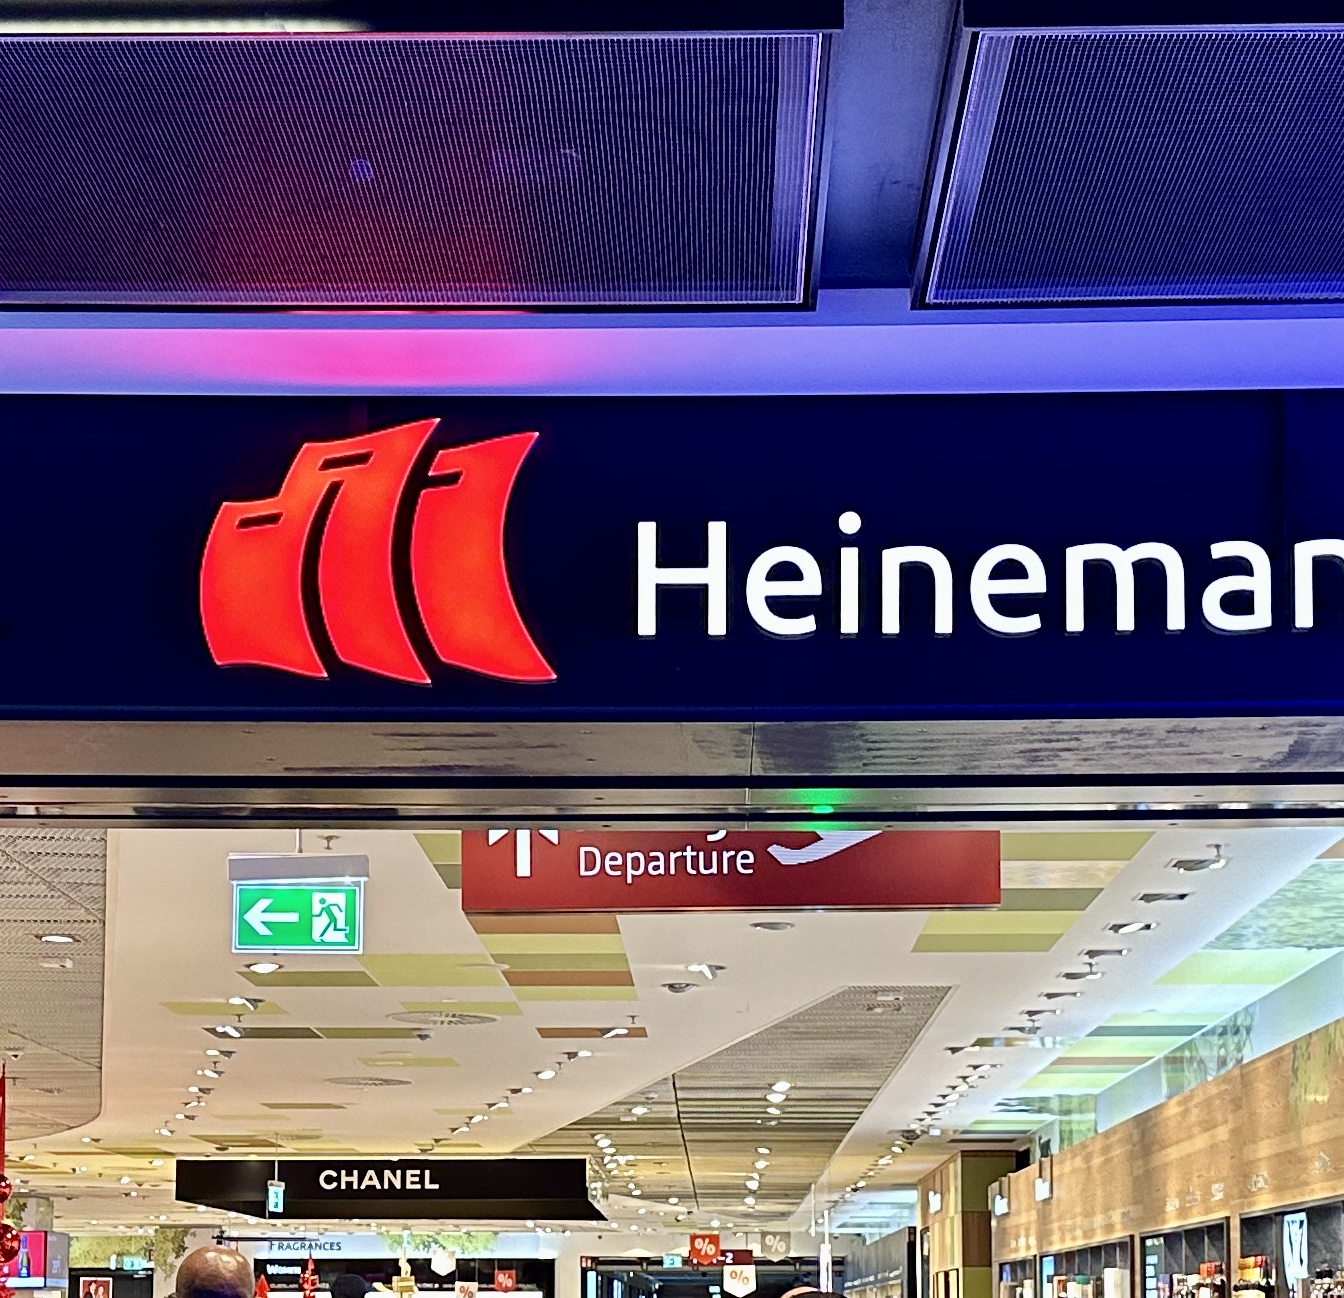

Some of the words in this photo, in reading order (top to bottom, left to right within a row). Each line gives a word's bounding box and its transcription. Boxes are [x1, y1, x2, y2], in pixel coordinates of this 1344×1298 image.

[578, 845, 755, 884] Departure
[318, 1169, 440, 1190] CHANEL
[269, 1241, 342, 1251] FRAGRANCES
